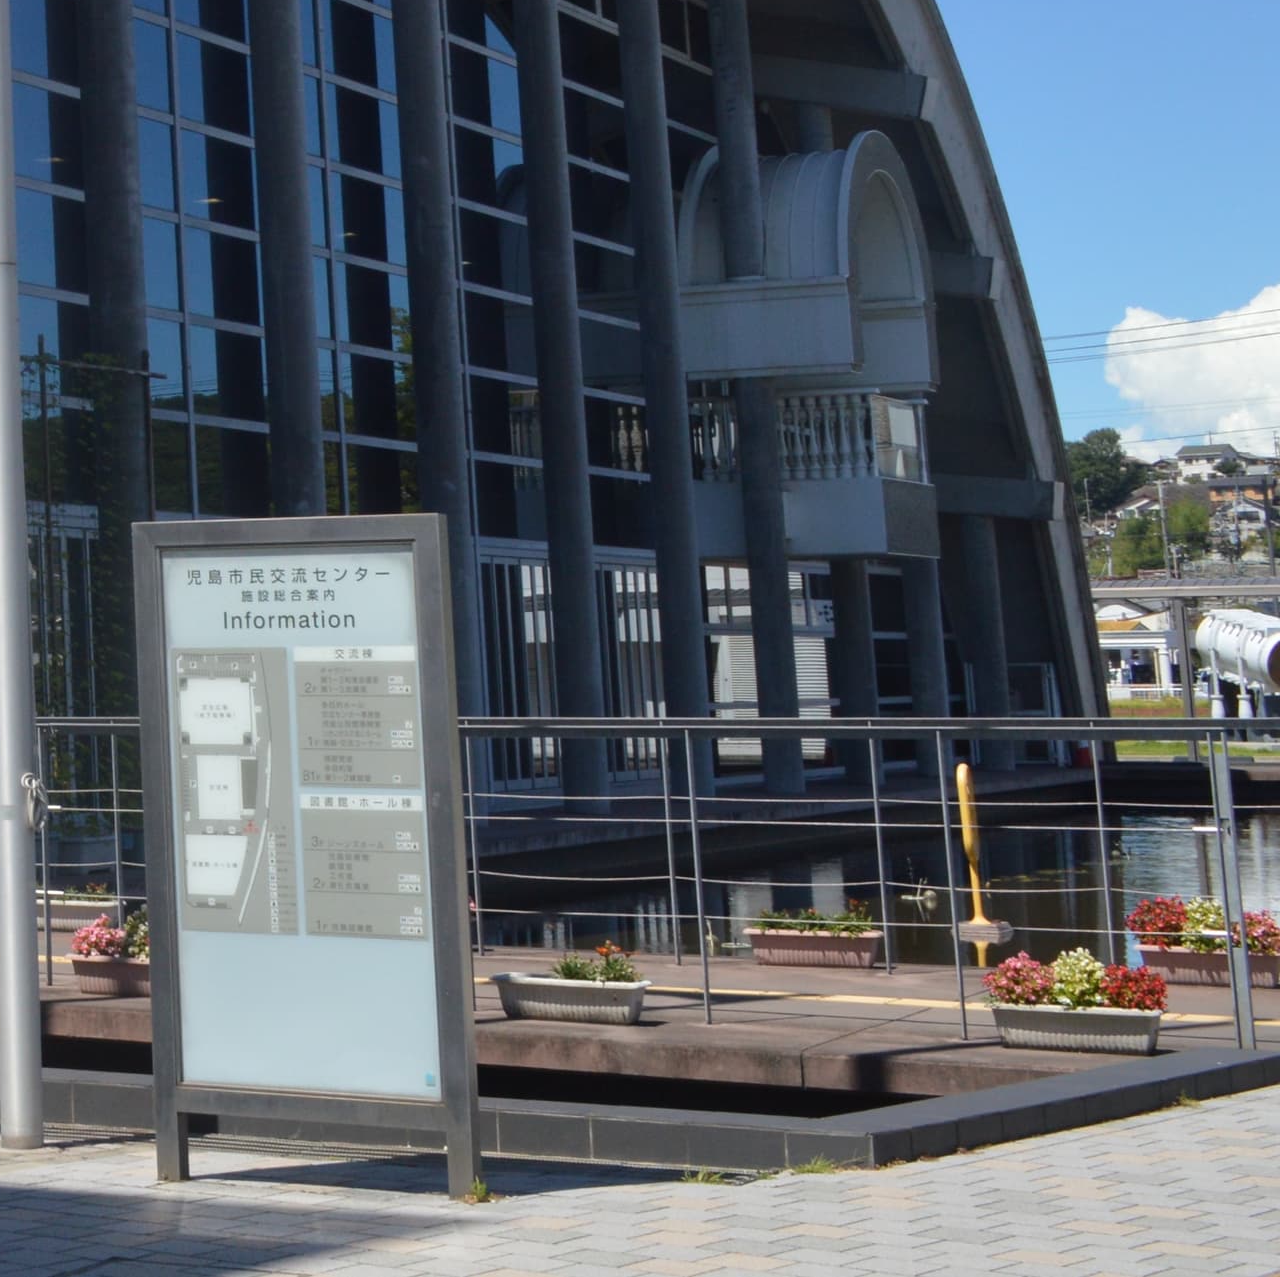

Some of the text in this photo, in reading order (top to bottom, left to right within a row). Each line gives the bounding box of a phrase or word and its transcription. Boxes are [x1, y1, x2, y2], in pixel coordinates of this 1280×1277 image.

[187, 567, 391, 585] 児島市民交流センター
[241, 589, 336, 603] 施設総合案内
[223, 610, 356, 629] Information
